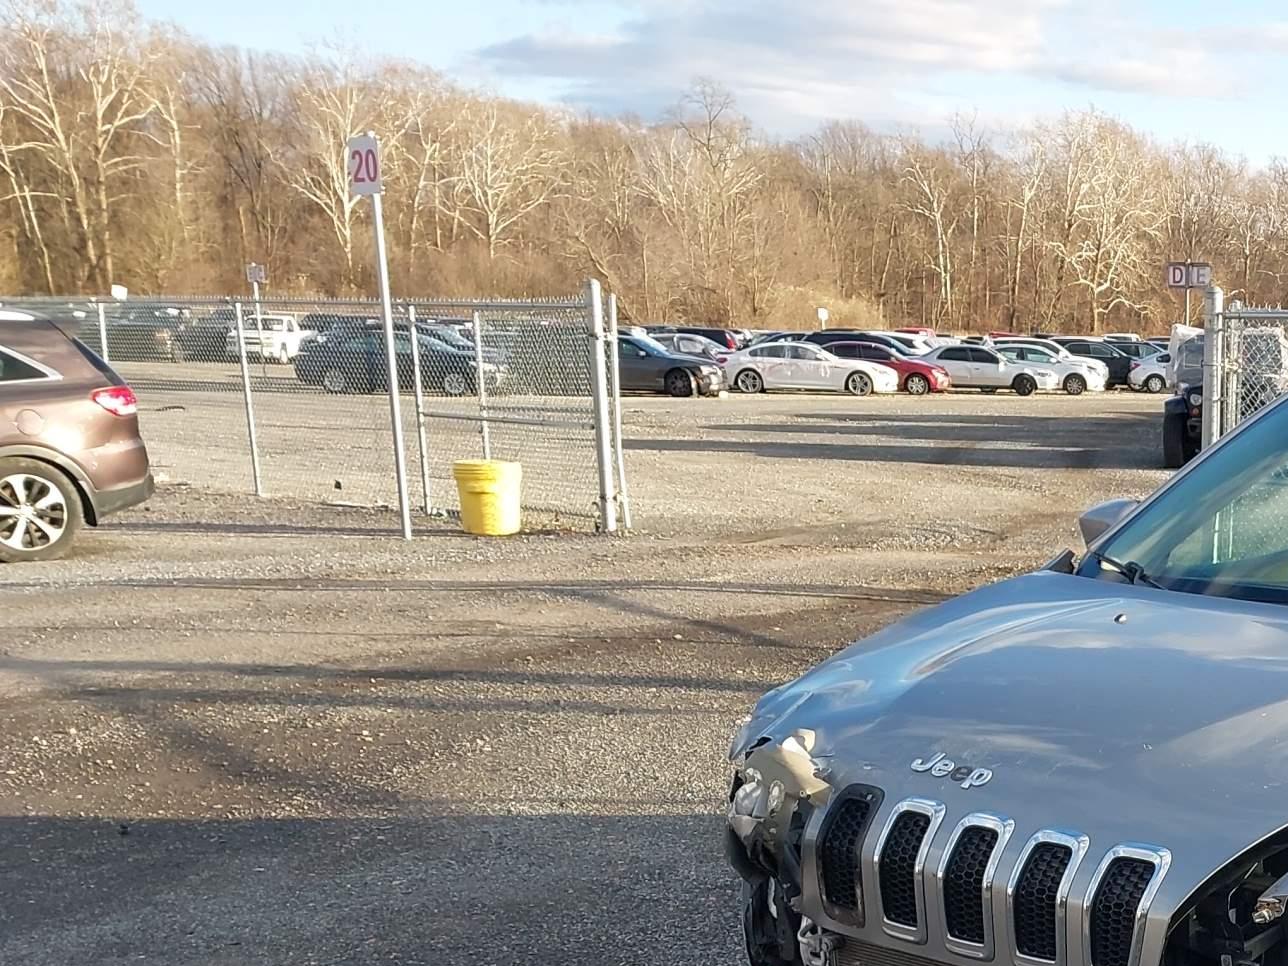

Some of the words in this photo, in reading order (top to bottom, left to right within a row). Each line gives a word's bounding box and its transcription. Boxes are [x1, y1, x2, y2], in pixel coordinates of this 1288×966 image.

[351, 148, 378, 183] 20
[1172, 266, 1184, 284] D
[910, 751, 993, 790] Jeep
